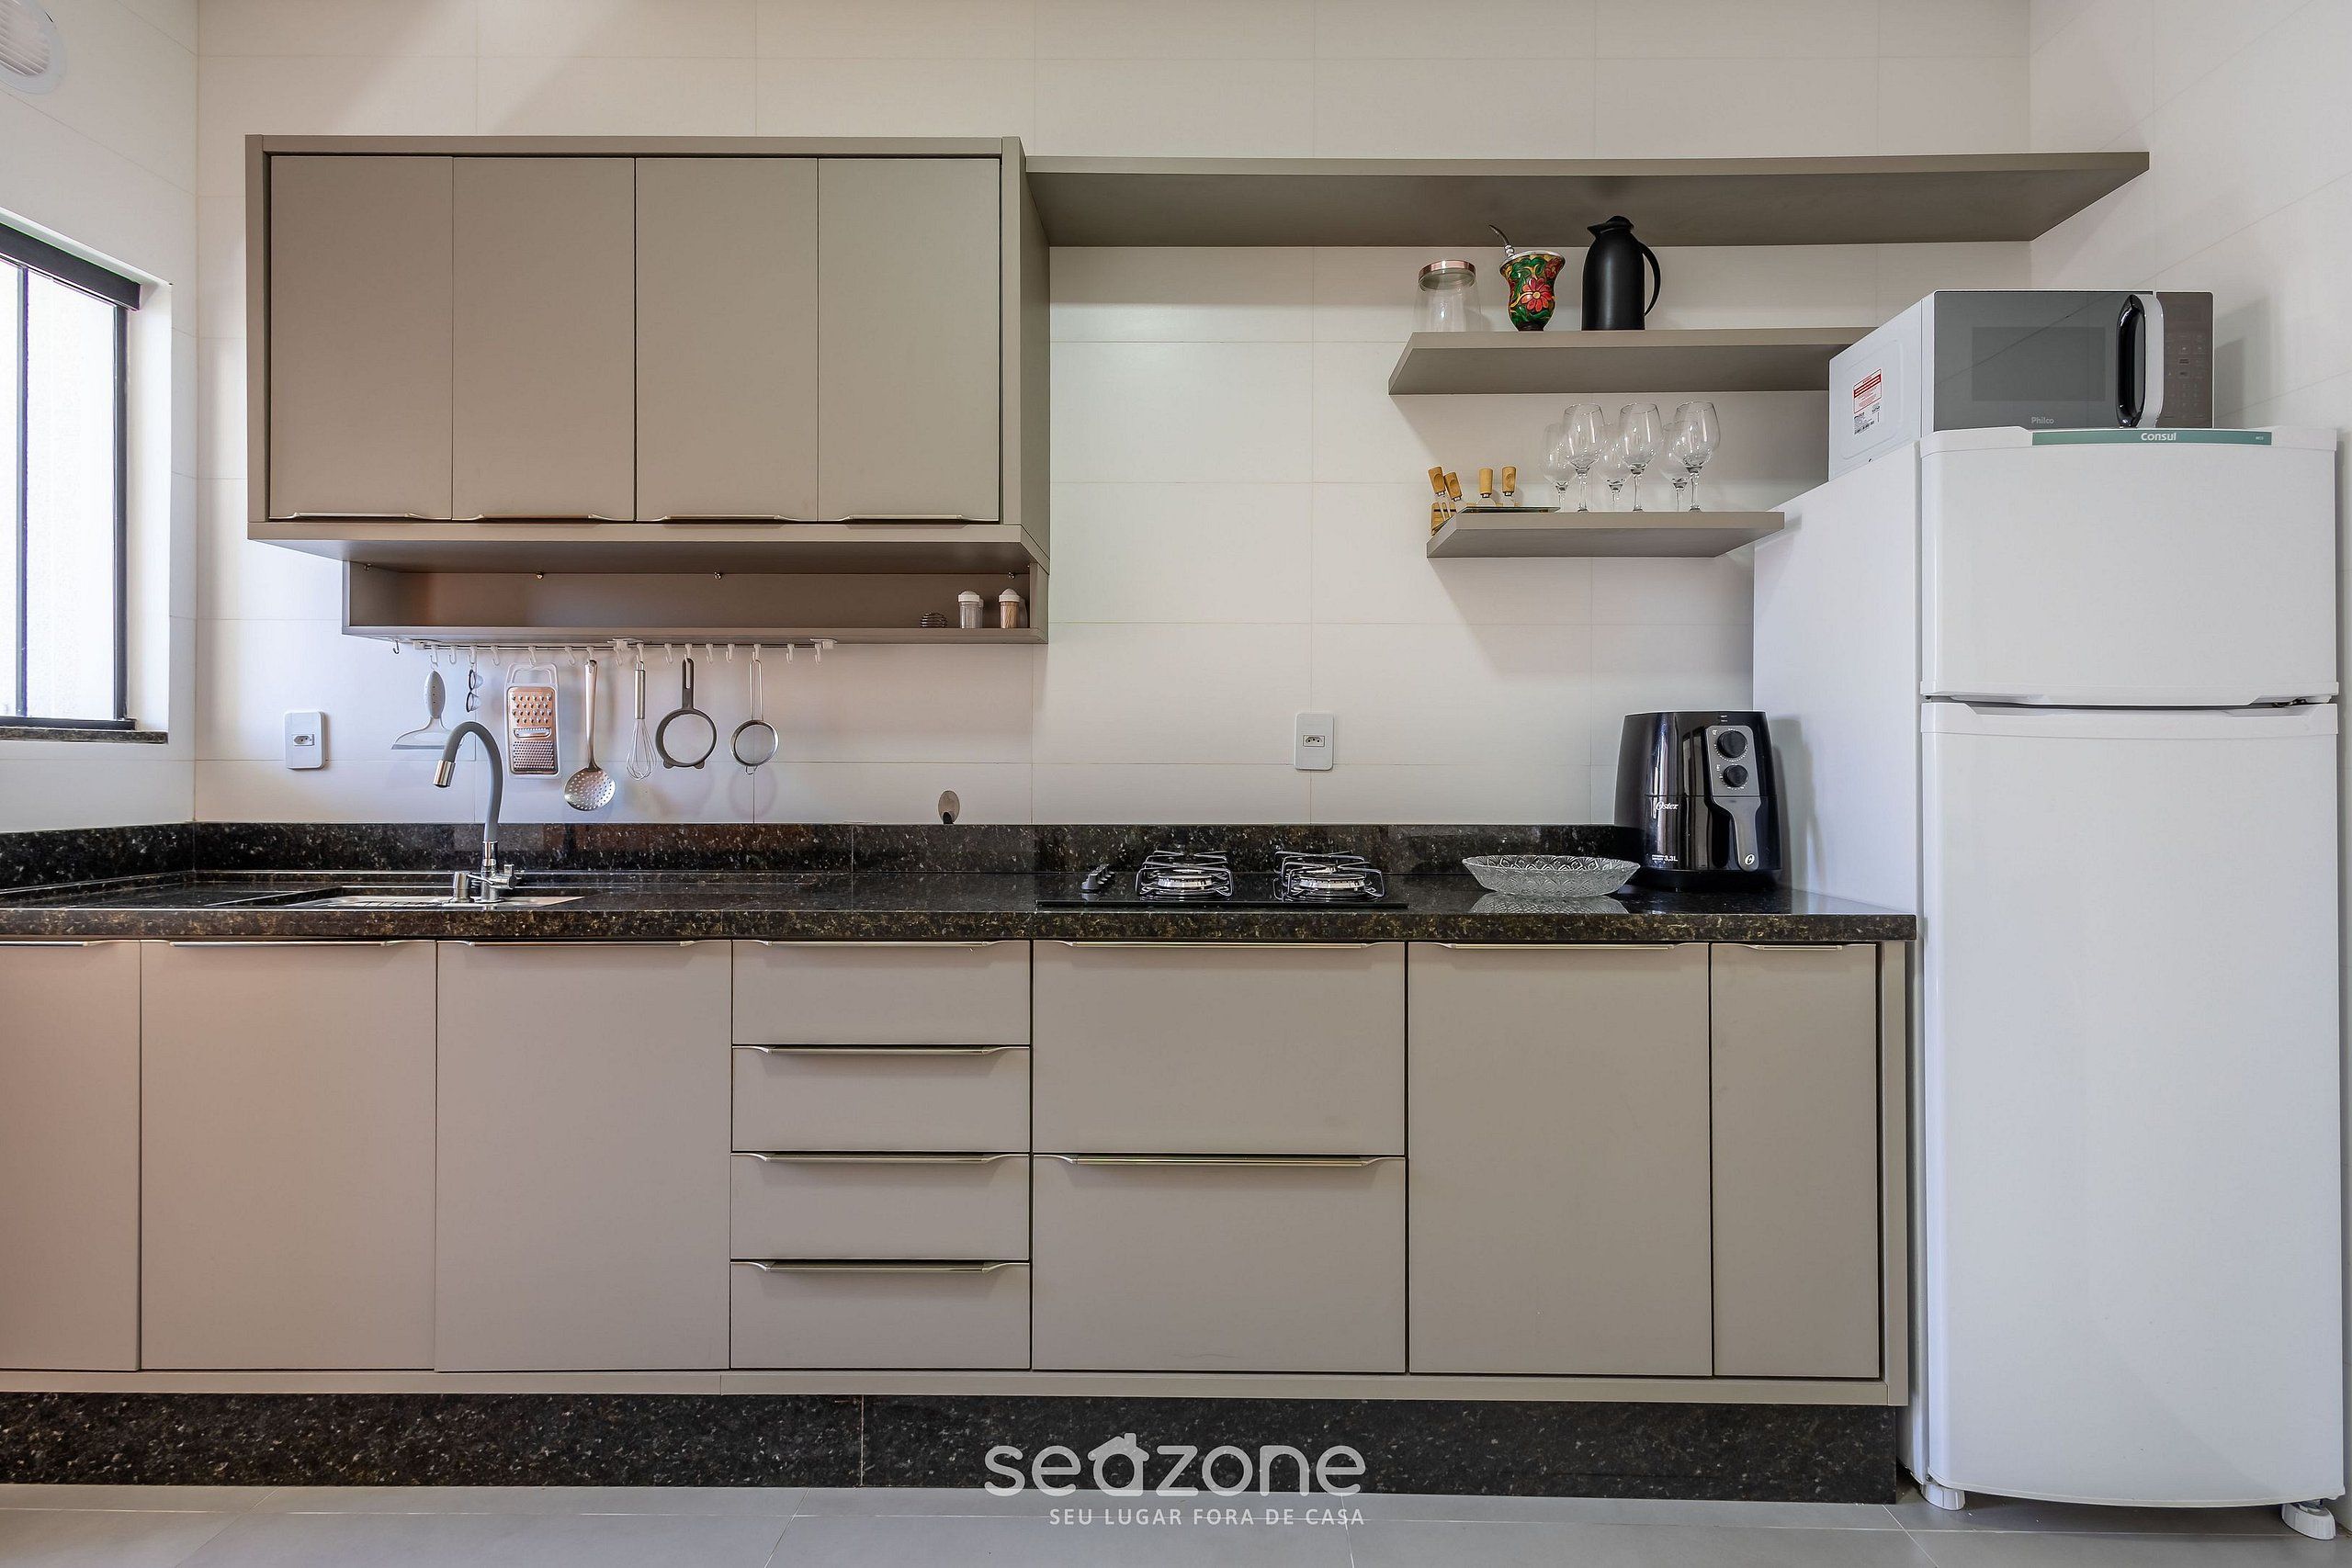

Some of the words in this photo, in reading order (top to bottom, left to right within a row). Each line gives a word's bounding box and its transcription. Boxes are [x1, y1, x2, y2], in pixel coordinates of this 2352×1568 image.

[2031, 416, 2054, 424] Philco
[2141, 432, 2177, 441] Consul
[1656, 801, 1679, 810] Oster
